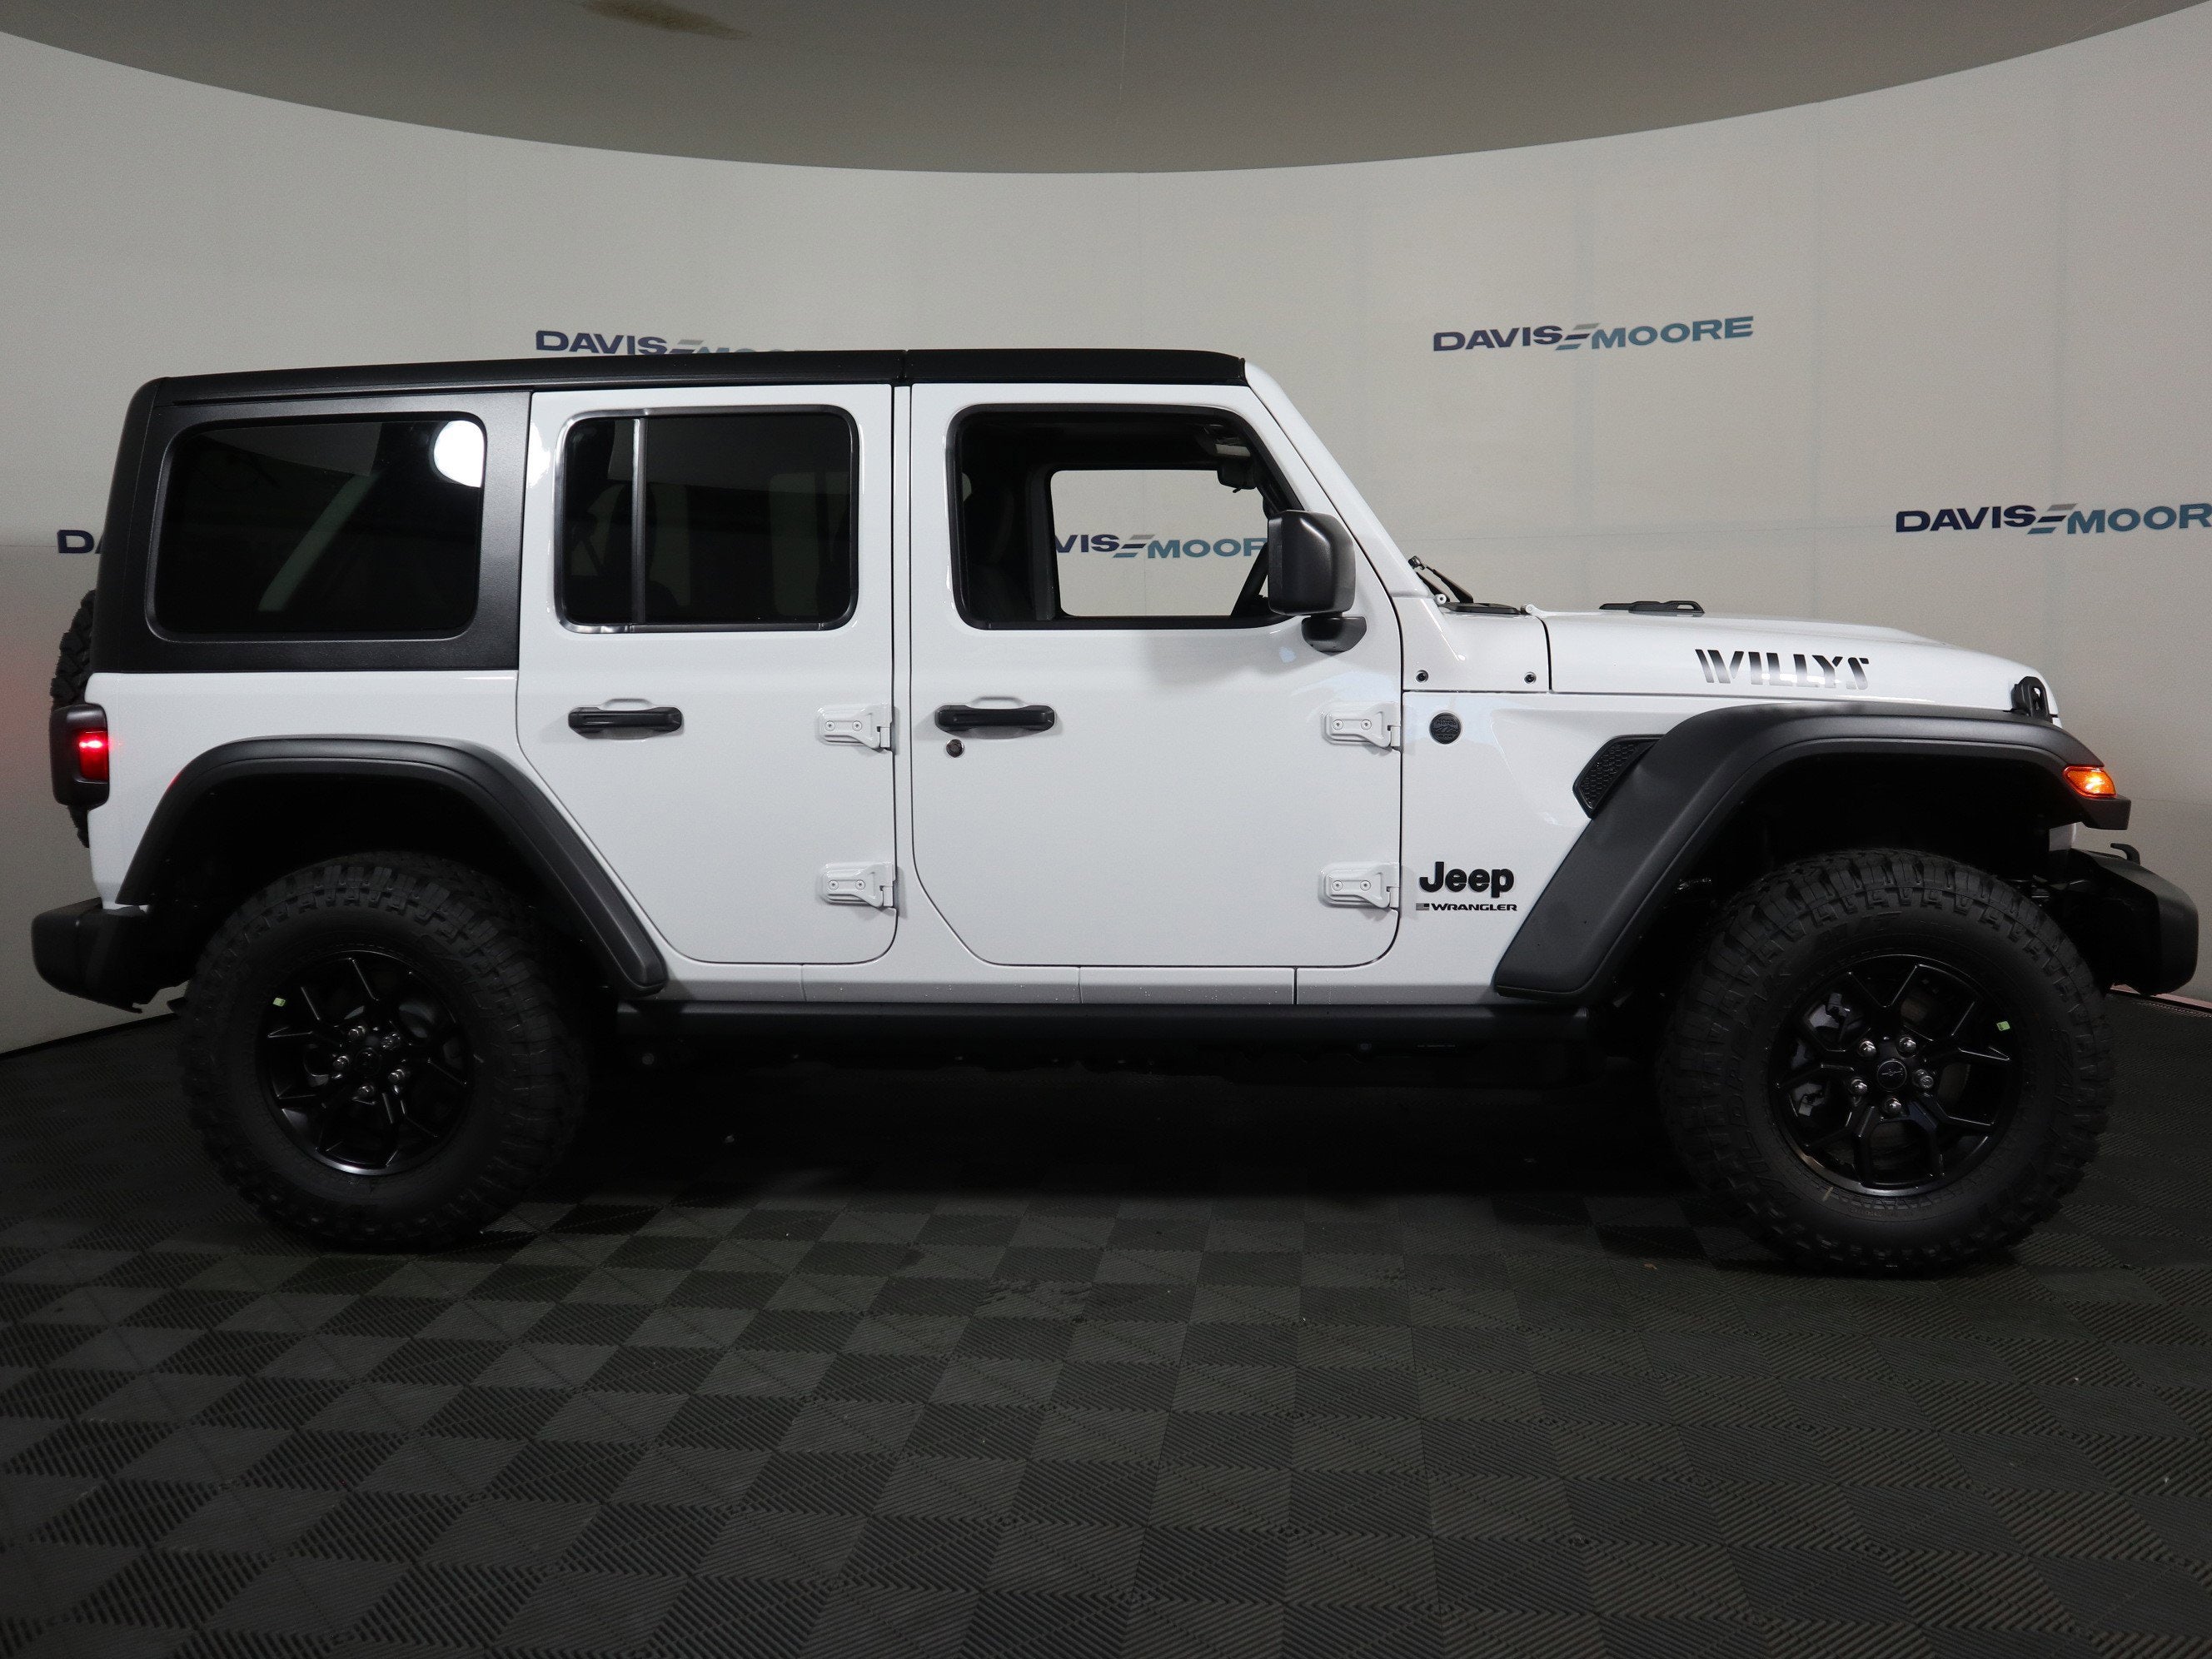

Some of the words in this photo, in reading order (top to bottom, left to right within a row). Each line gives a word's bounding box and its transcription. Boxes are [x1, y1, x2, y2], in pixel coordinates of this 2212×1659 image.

[536, 330, 667, 356] DAVIS
[1433, 326, 1562, 351] DAVIS
[1592, 316, 1754, 349] MOORE
[1896, 505, 2036, 532] DAVIS
[2067, 503, 2212, 534] MOOR
[1055, 534, 1119, 553] VIS
[1695, 649, 1869, 690] WILLYS
[1419, 861, 1514, 898] Jeep
[1431, 903, 1517, 912] WRANGLER
